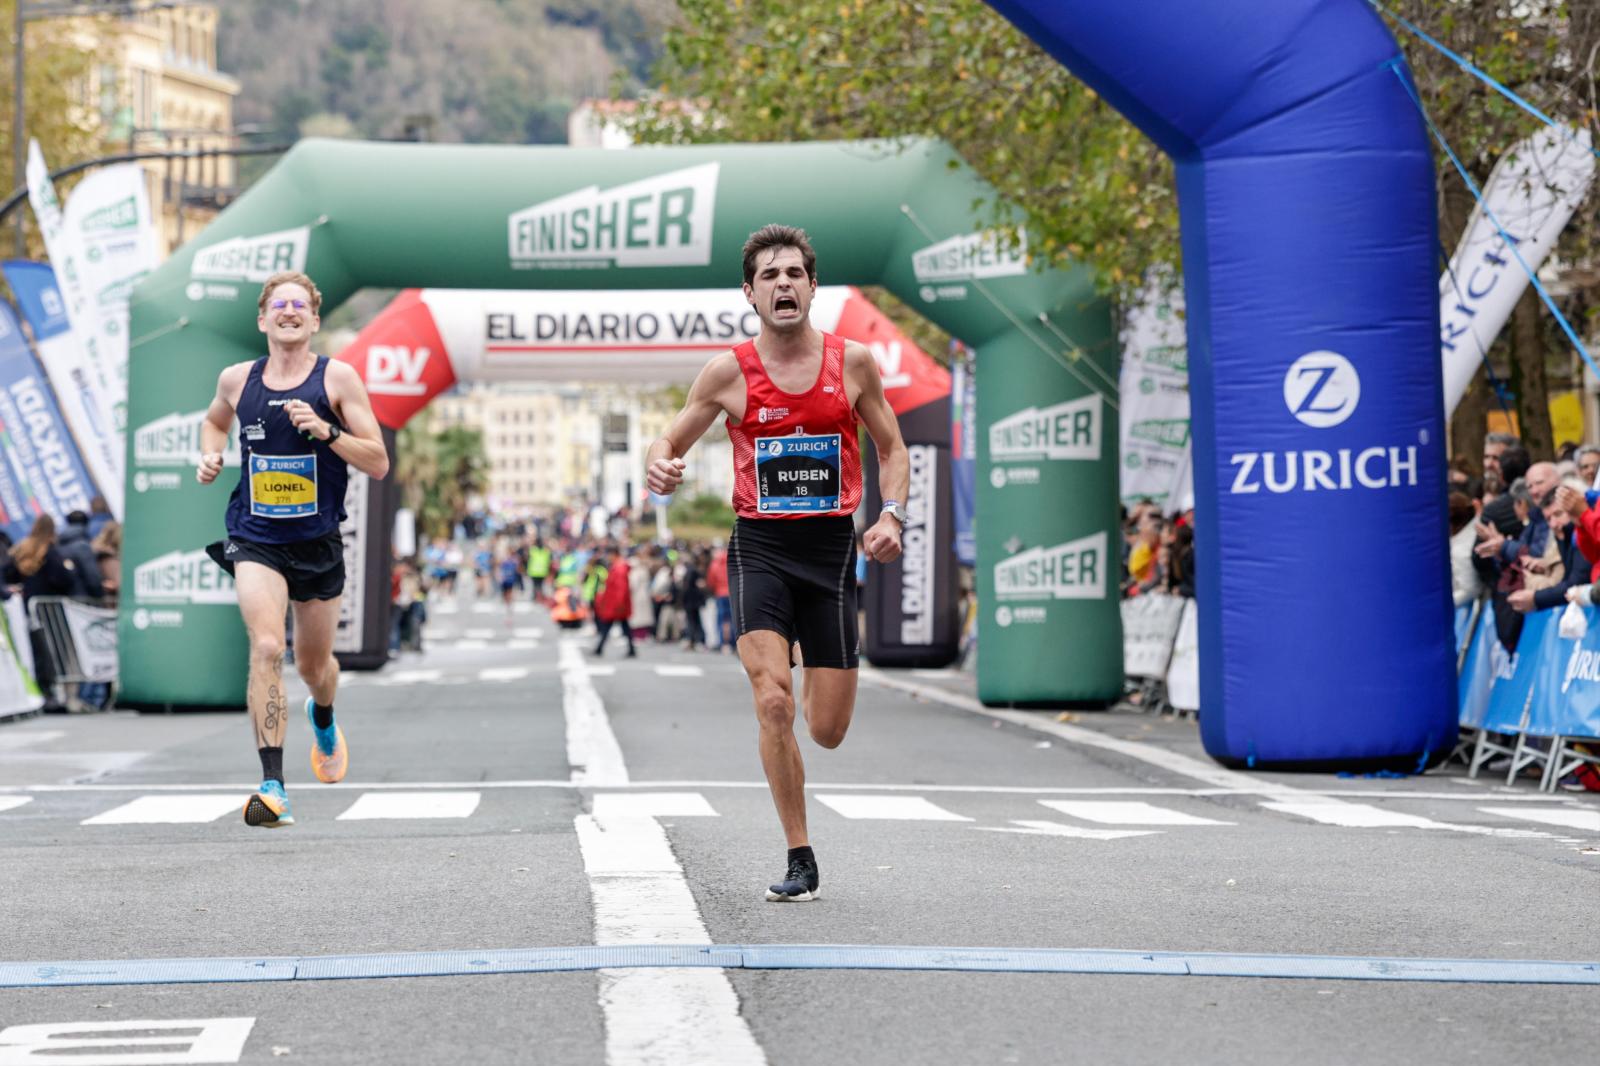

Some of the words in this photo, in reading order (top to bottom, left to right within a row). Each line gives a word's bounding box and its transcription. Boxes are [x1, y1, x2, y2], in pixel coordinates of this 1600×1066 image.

[518, 187, 694, 253] FINISHER
[1440, 231, 1519, 351] RICH
[487, 314, 525, 339] EL
[536, 313, 659, 339] DIARIO
[670, 312, 758, 338] VASC
[367, 347, 431, 383] DV
[787, 442, 828, 452] ZURICH
[271, 461, 305, 469] ZURICH
[1231, 446, 1417, 493] ZURICH
[778, 469, 829, 482] RUBEN
[264, 483, 306, 492] LIONEL
[796, 486, 808, 496] 18
